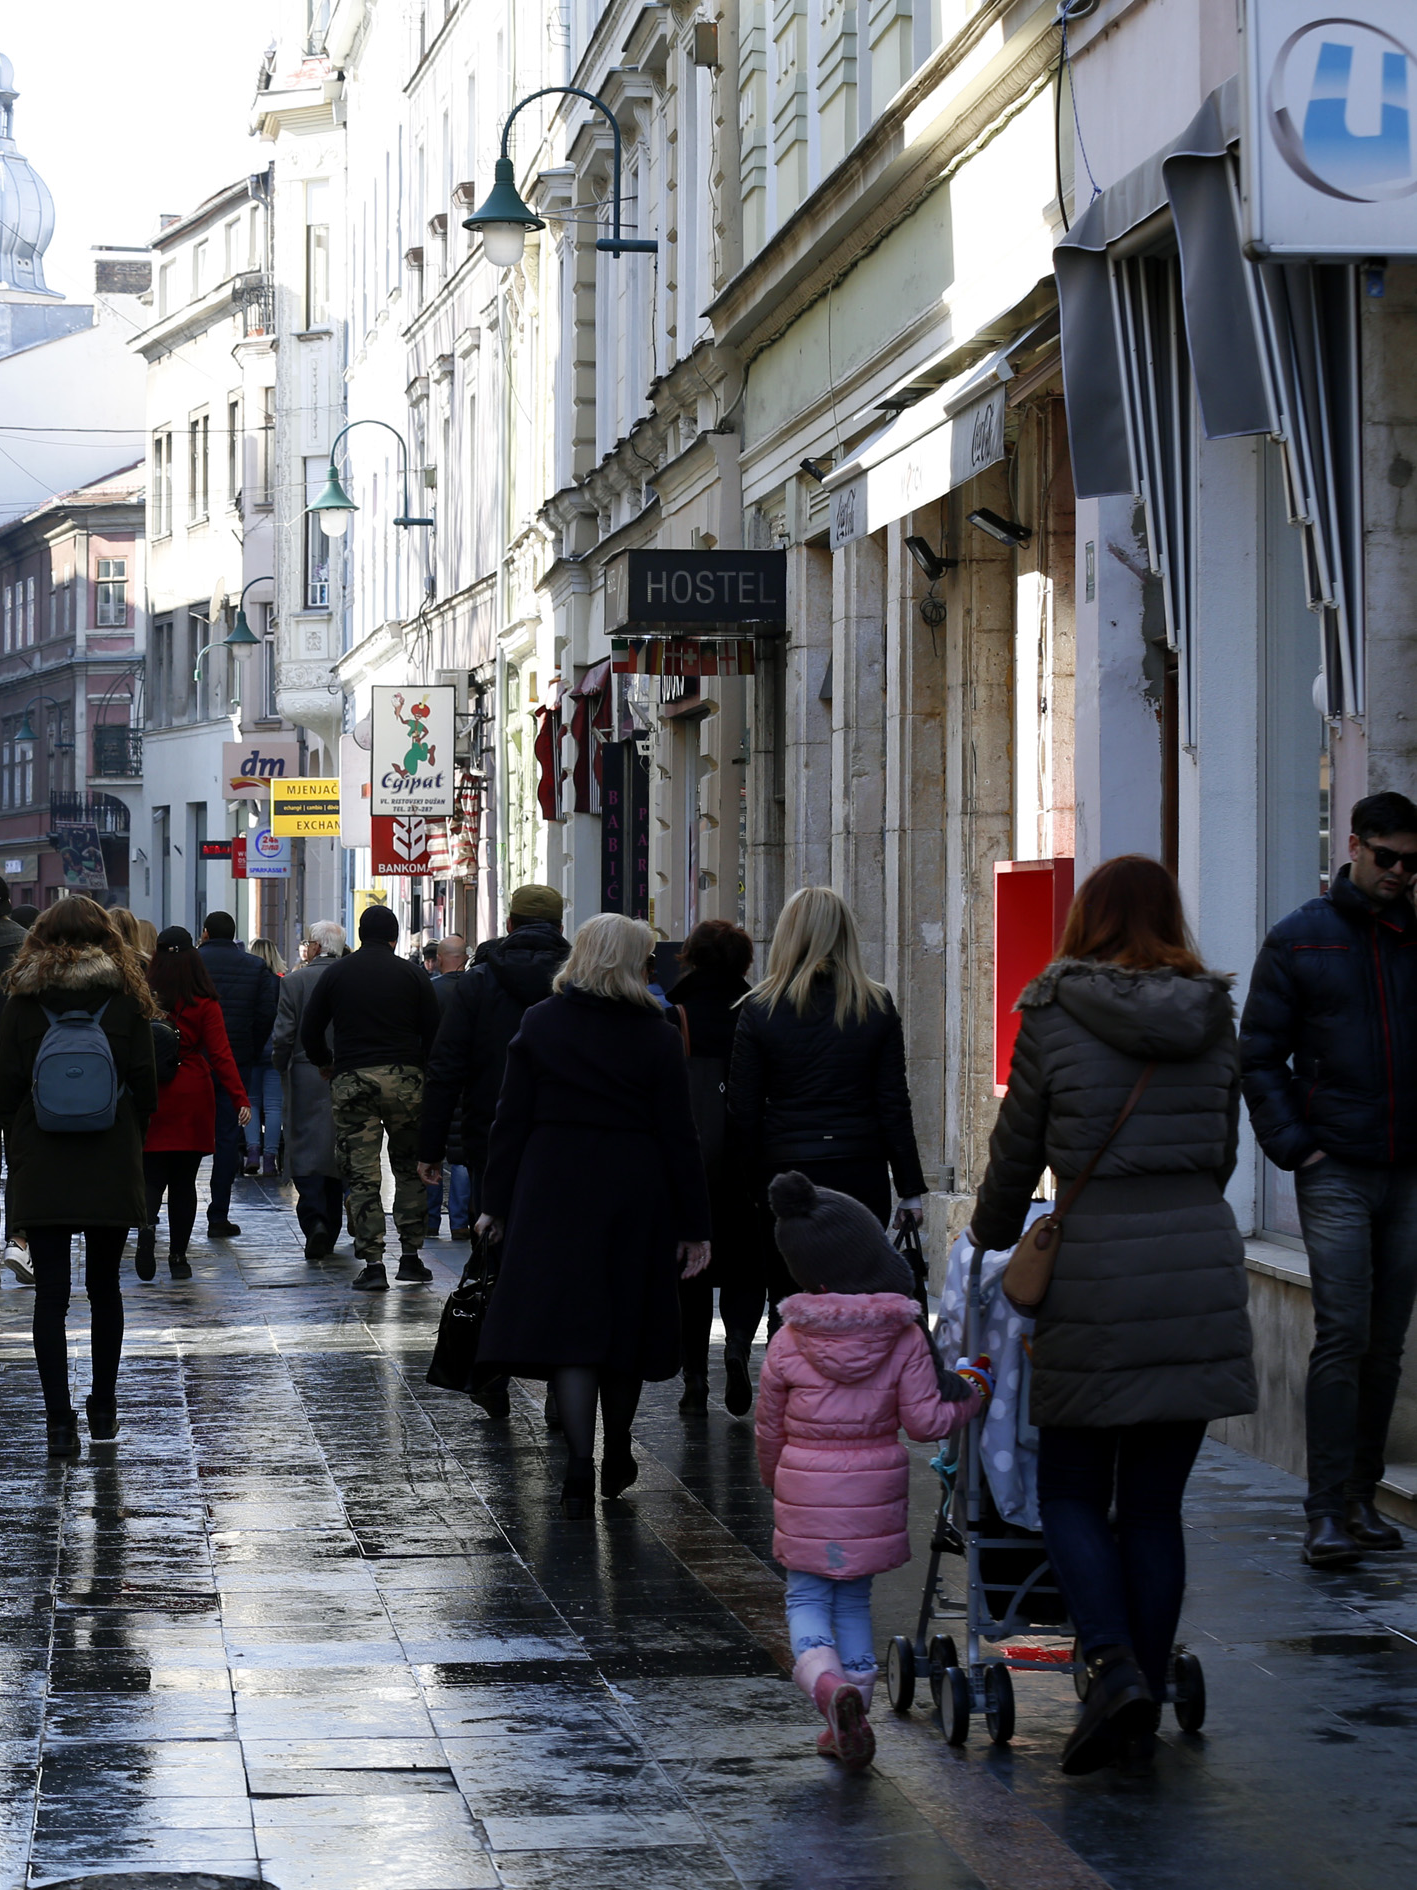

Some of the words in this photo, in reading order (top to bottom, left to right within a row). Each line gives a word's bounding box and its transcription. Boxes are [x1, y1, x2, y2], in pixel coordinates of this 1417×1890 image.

[647, 570, 777, 603] HOSTEL
[240, 750, 286, 777] dm
[286, 783, 339, 795] MJENJAČ
[381, 770, 446, 796] Egipat
[607, 789, 619, 900] BABIĆ
